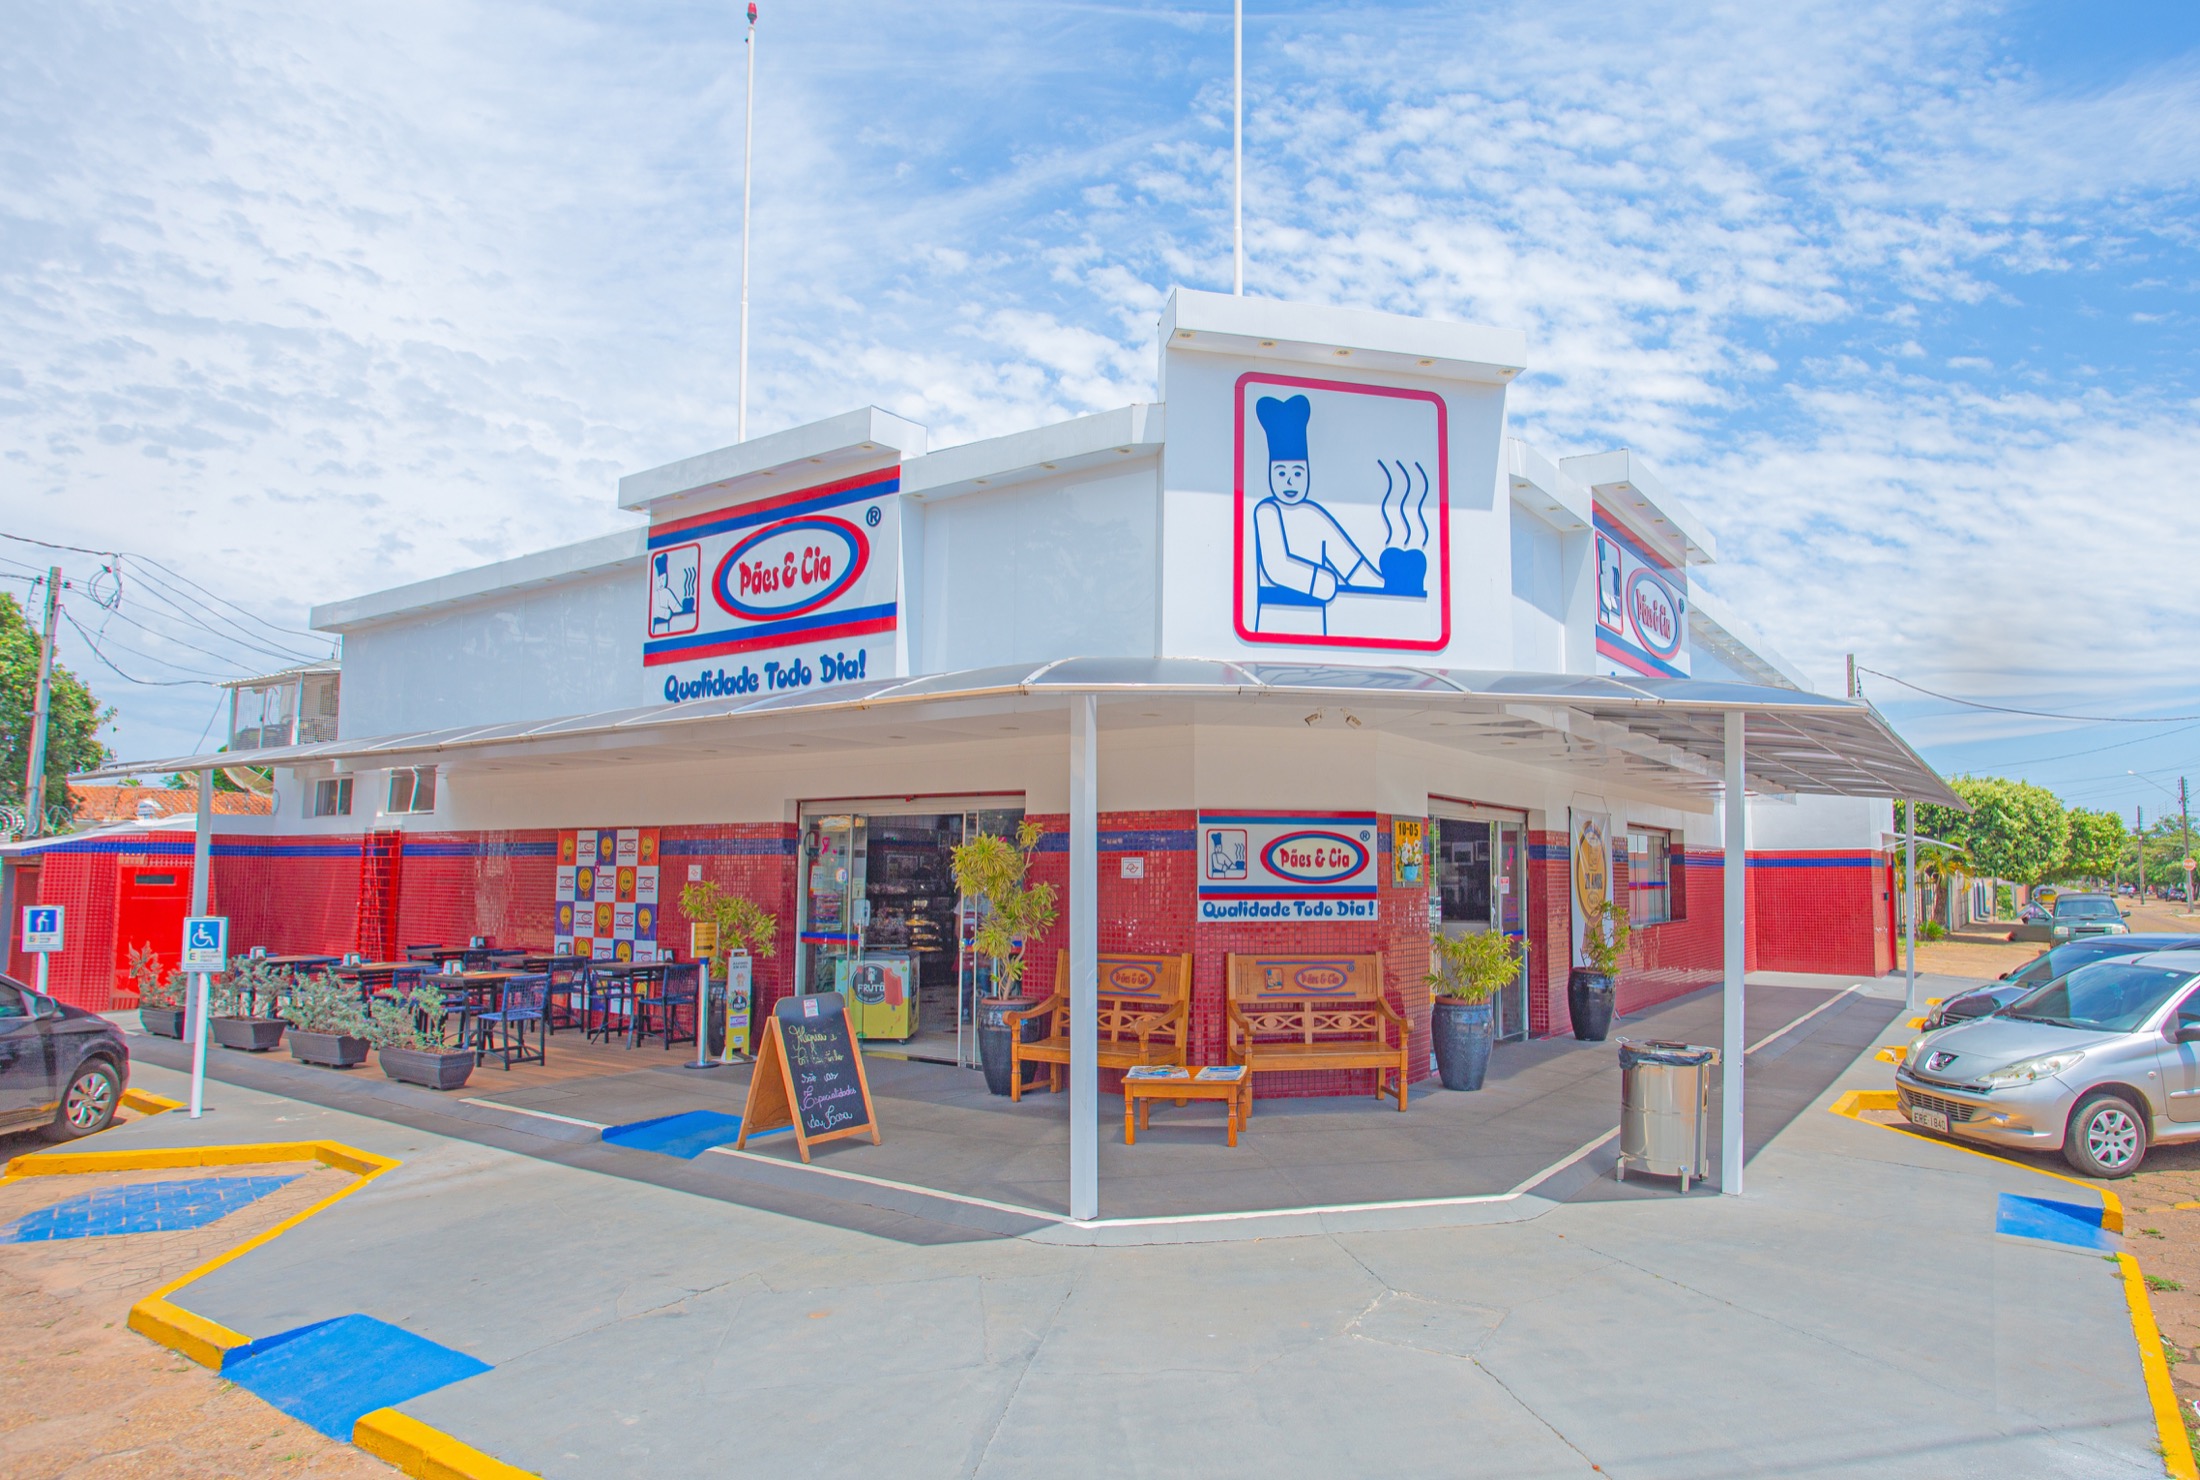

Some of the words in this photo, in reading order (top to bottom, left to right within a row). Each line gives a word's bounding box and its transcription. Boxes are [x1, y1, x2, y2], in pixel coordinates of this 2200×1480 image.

[739, 561, 779, 596] Pães
[782, 552, 798, 588] &
[801, 546, 831, 585] Cia
[664, 666, 759, 703] Qualidade
[764, 657, 812, 690] Todo
[820, 649, 866, 683] Dia!
[1398, 822, 1419, 837] 10-05
[1280, 848, 1311, 868] Pães
[1315, 848, 1325, 868] &
[1329, 848, 1350, 868] Cia
[1203, 901, 1290, 919] Qualidade
[1294, 901, 1333, 917] Todo
